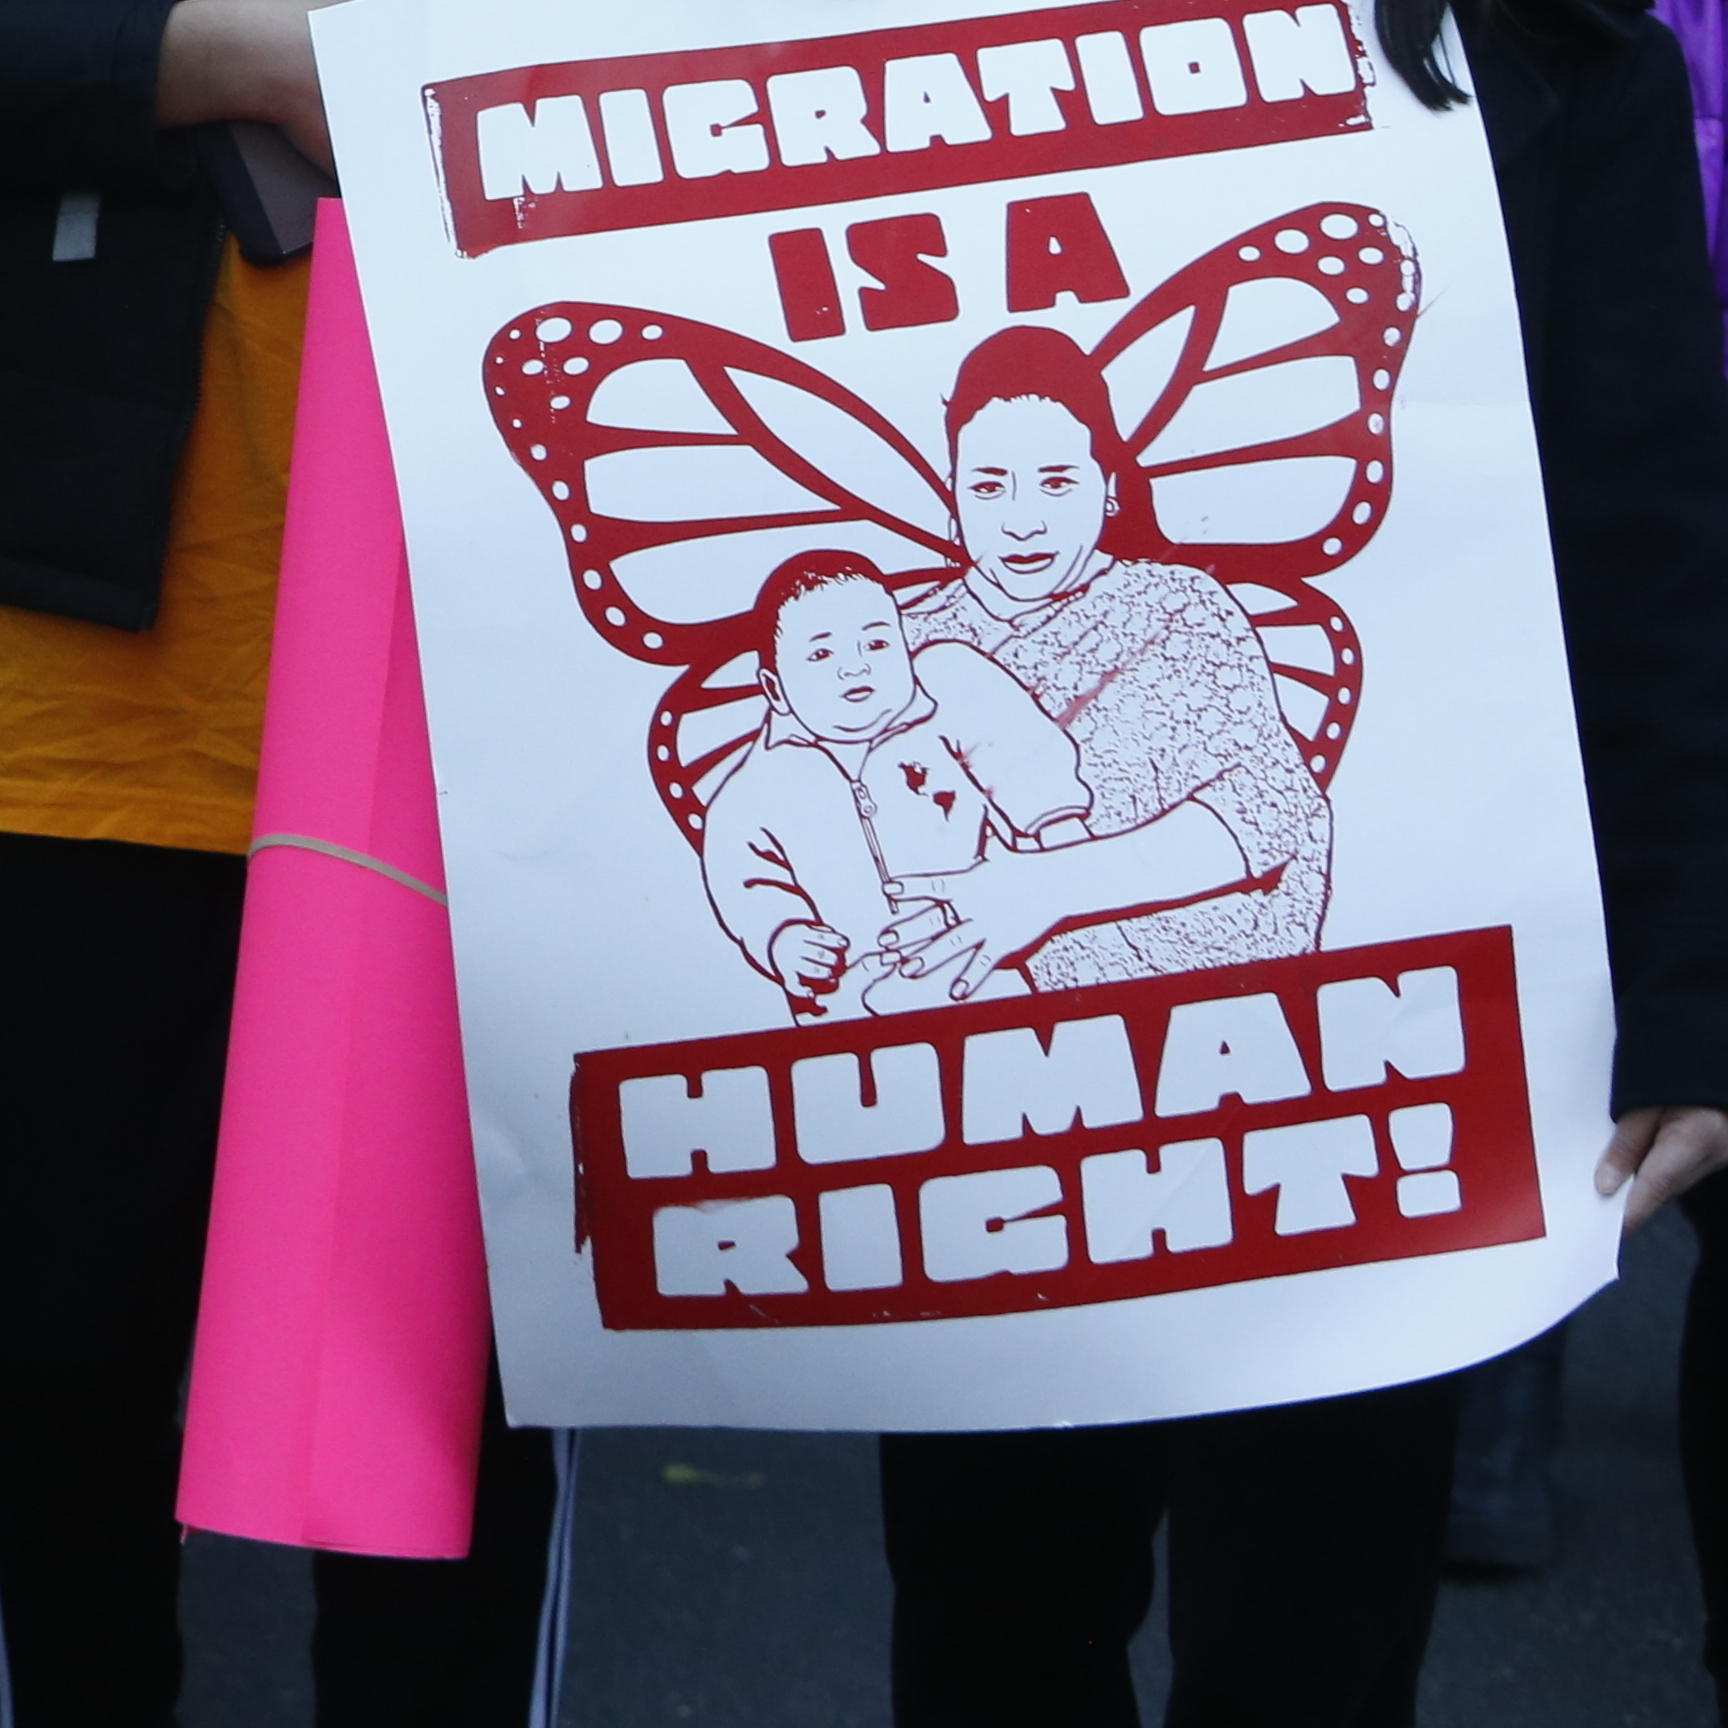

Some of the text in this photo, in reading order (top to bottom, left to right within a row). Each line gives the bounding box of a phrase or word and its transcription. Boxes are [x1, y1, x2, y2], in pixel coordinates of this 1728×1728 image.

[475, 4, 1360, 201] MIGRATION
[766, 191, 1131, 342] IS A
[618, 965, 1465, 1180] HUMAN
[652, 1103, 1462, 1298] RIGHT!
